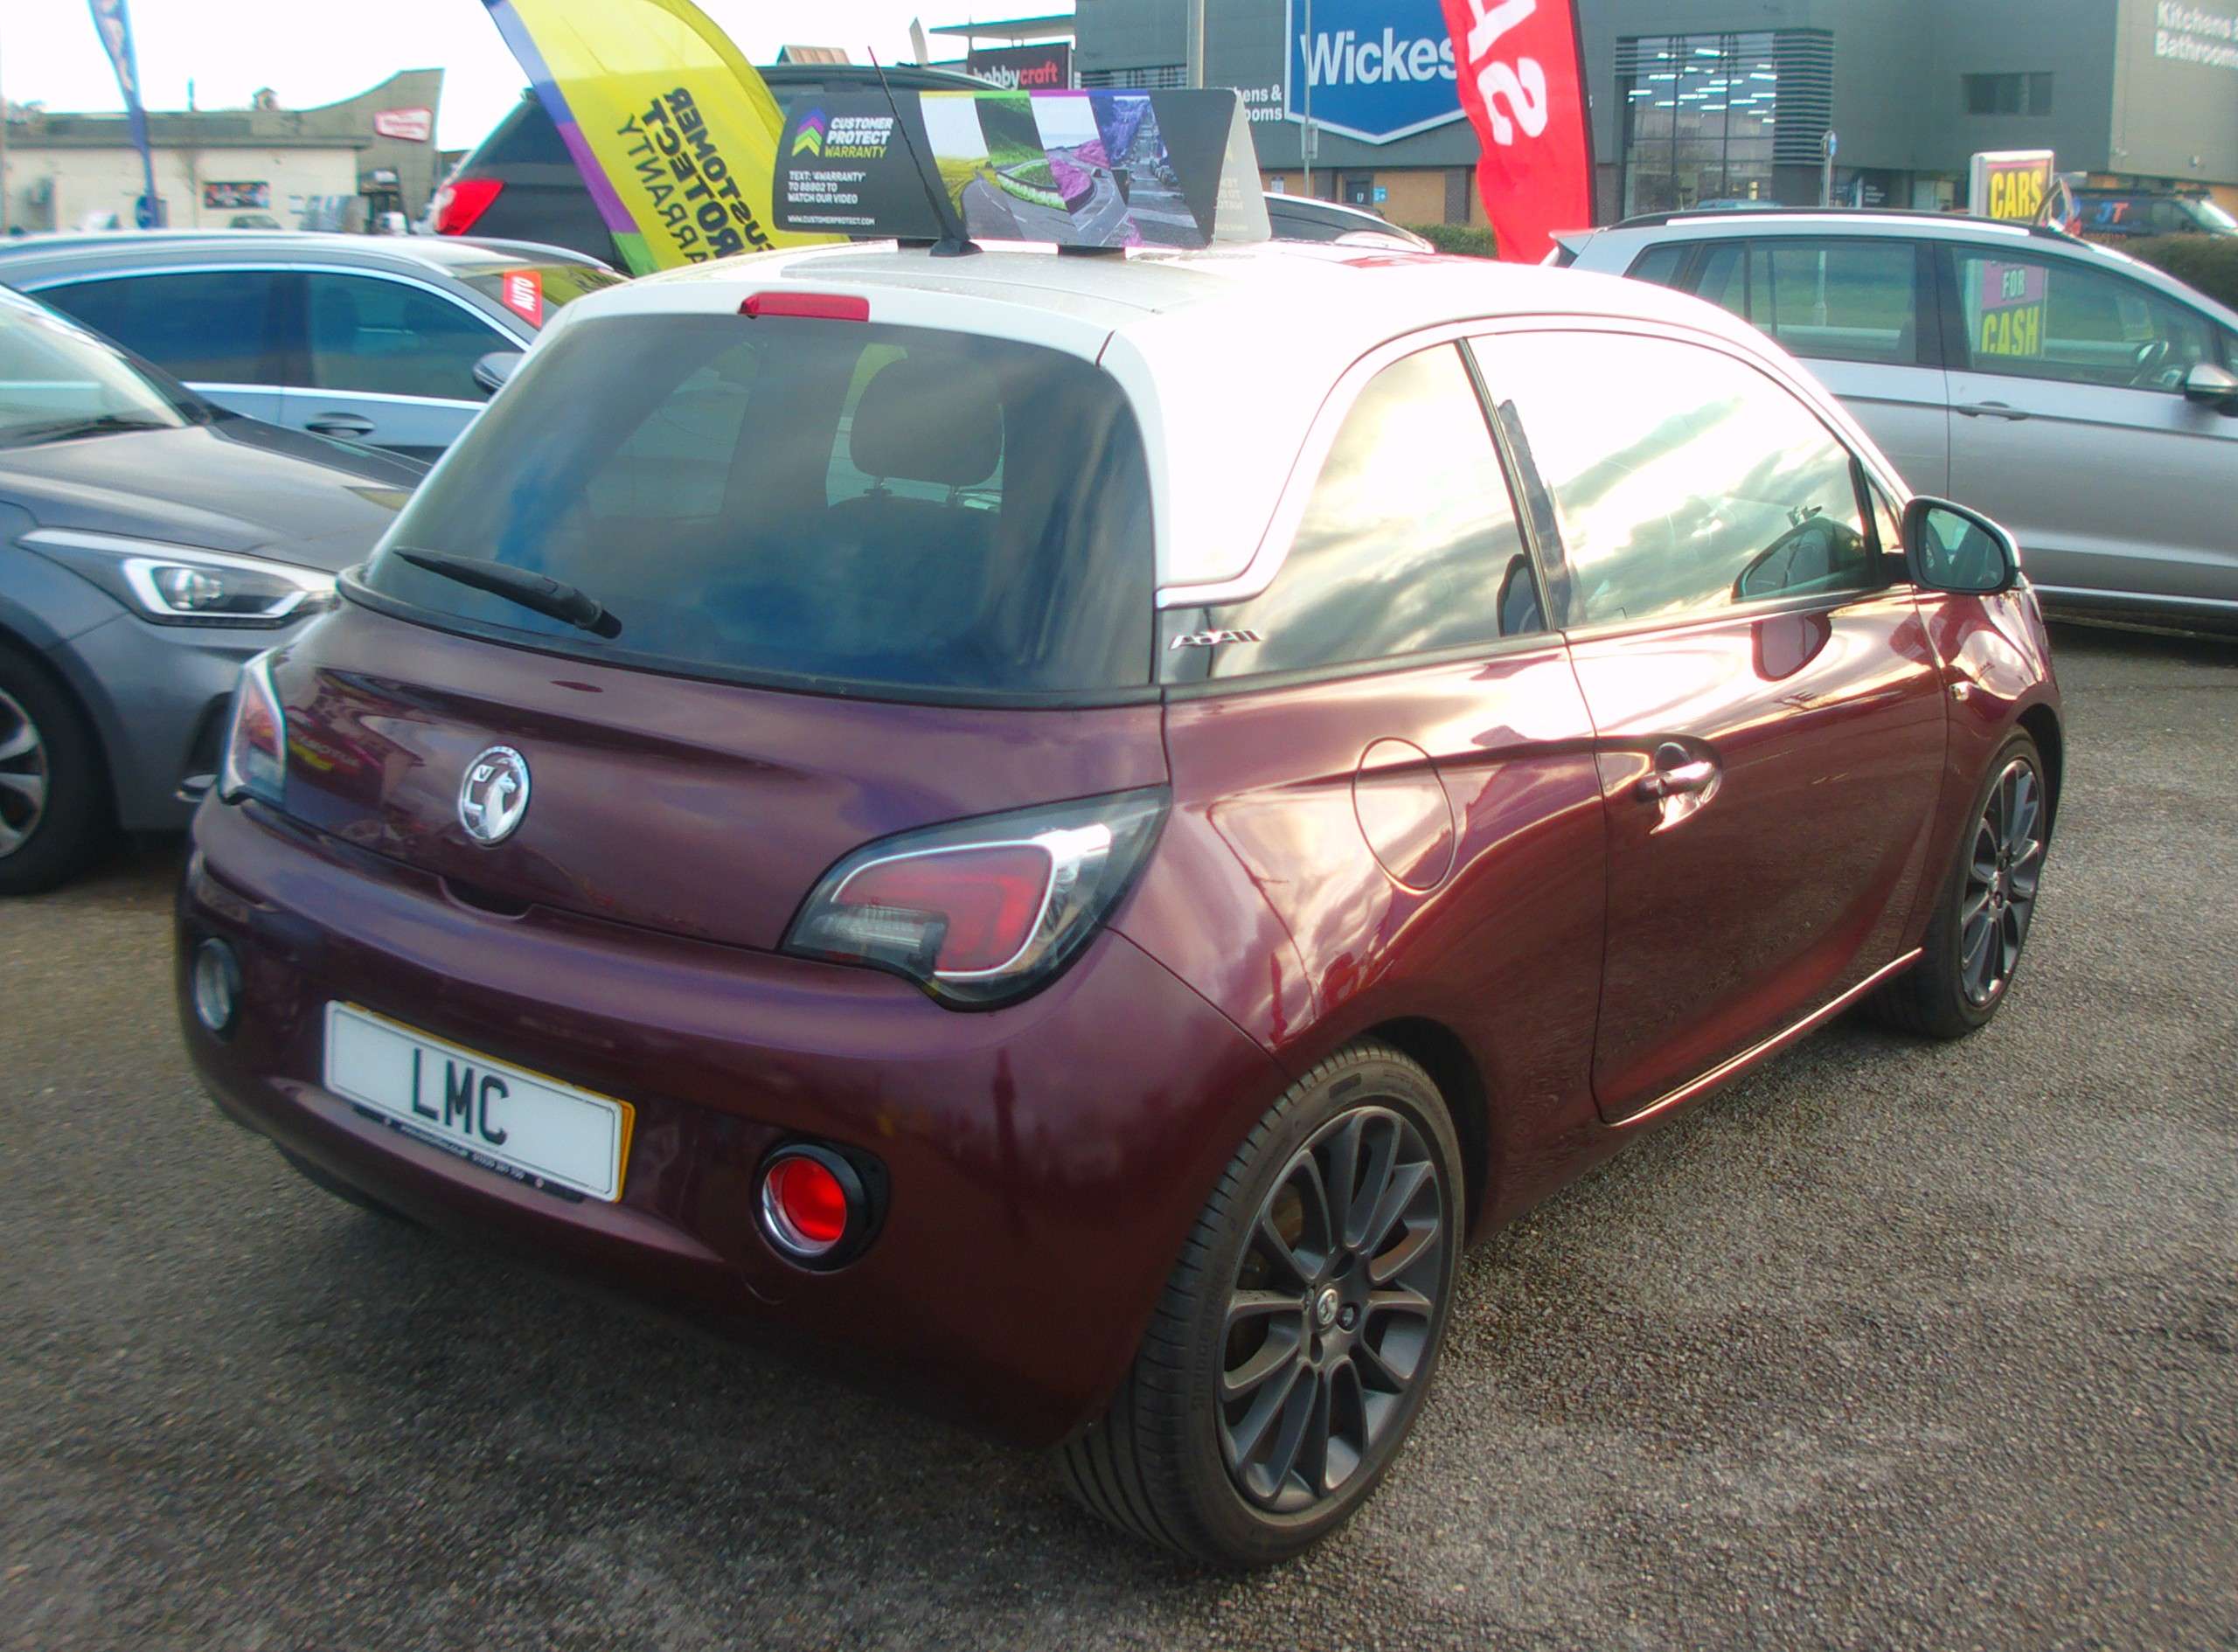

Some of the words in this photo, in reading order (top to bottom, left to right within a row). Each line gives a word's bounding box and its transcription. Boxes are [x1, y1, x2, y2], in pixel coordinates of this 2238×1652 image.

[1300, 27, 1458, 87] Wickes
[826, 130, 891, 145] PROTECT
[830, 117, 893, 130] CUSTOMER
[824, 145, 887, 158] WARRANTY
[788, 192, 815, 203] WATCH
[816, 193, 833, 204] OUR
[833, 193, 858, 205] VIDEO
[789, 182, 799, 191] TO
[827, 182, 838, 192] TO
[1990, 170, 2043, 219] CARS
[511, 275, 537, 312] AUTO
[2003, 269, 2025, 299] FOR
[1981, 307, 2040, 357] CASH
[412, 1047, 510, 1146] LMC
